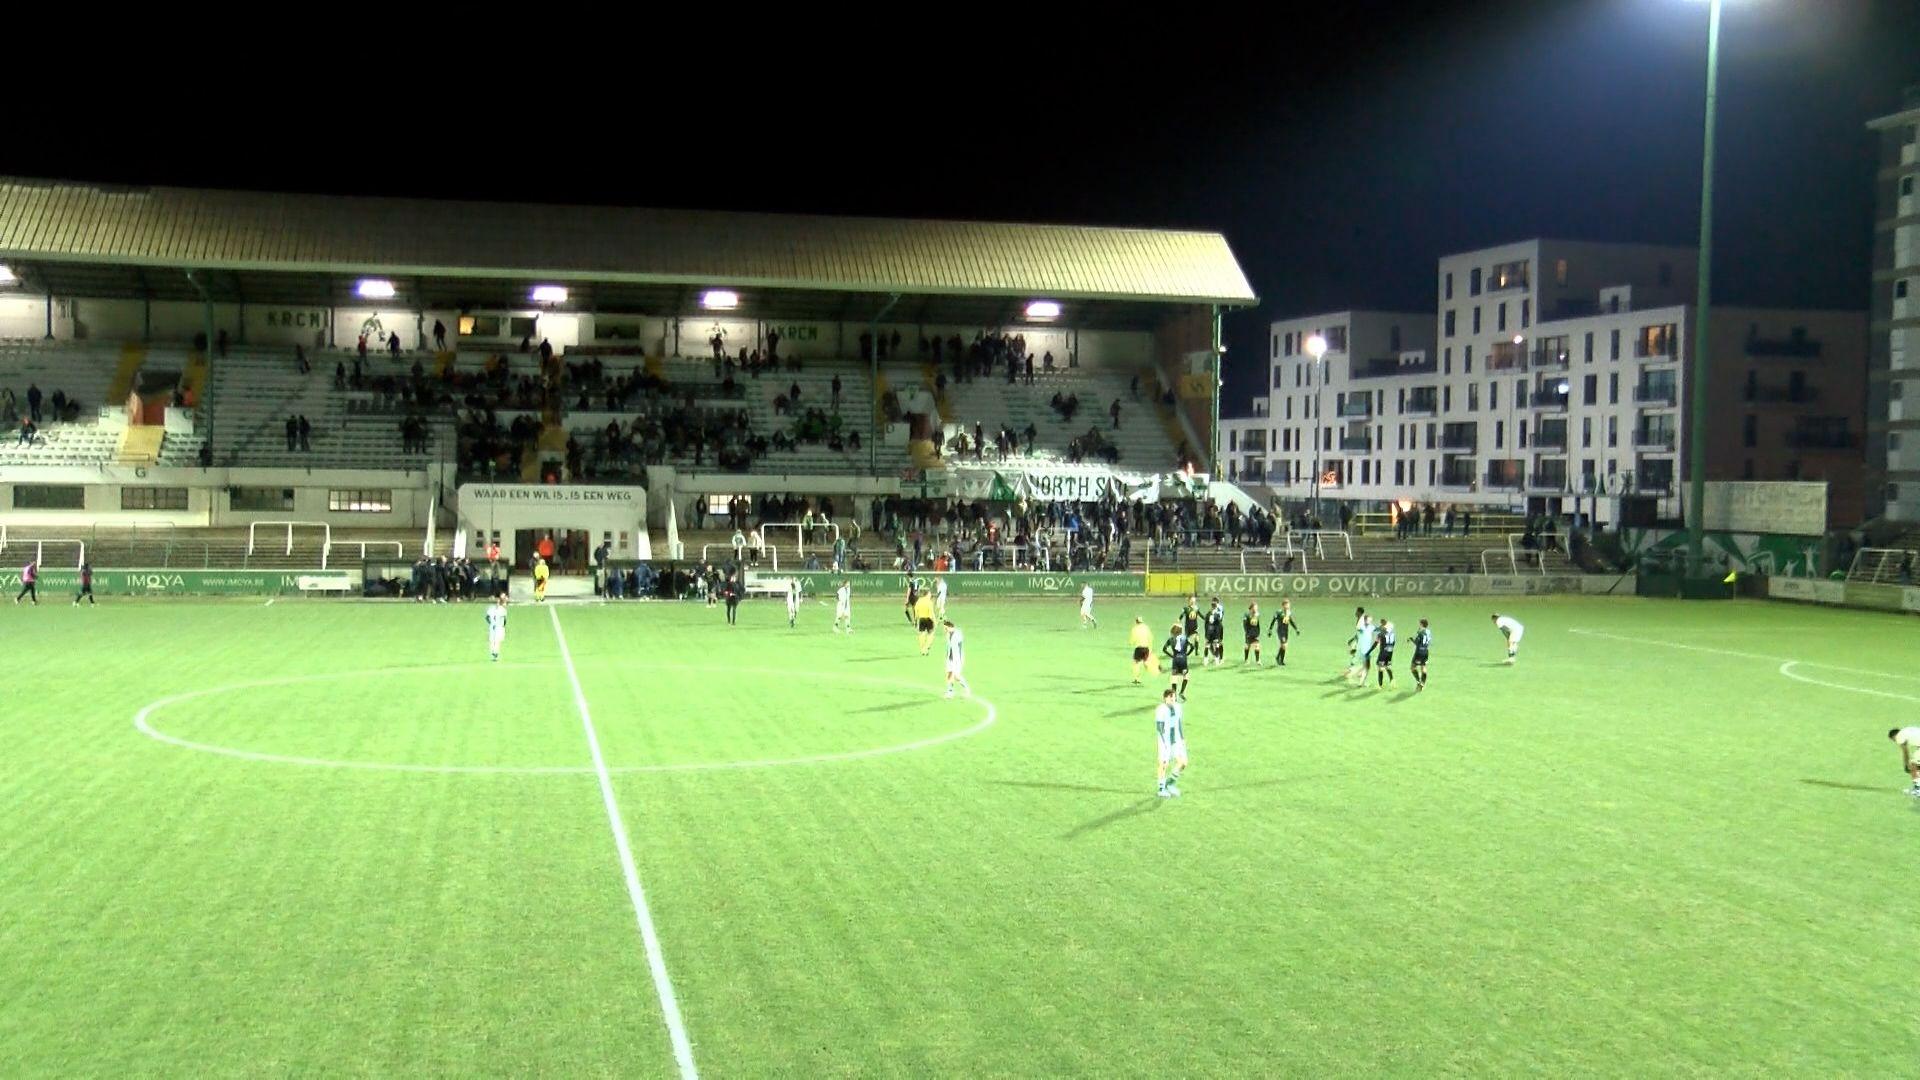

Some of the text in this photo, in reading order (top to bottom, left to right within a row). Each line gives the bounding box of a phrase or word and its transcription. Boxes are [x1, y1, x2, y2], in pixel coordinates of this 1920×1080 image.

[1203, 577, 1465, 594] RACING OP OVK! (For 24)
